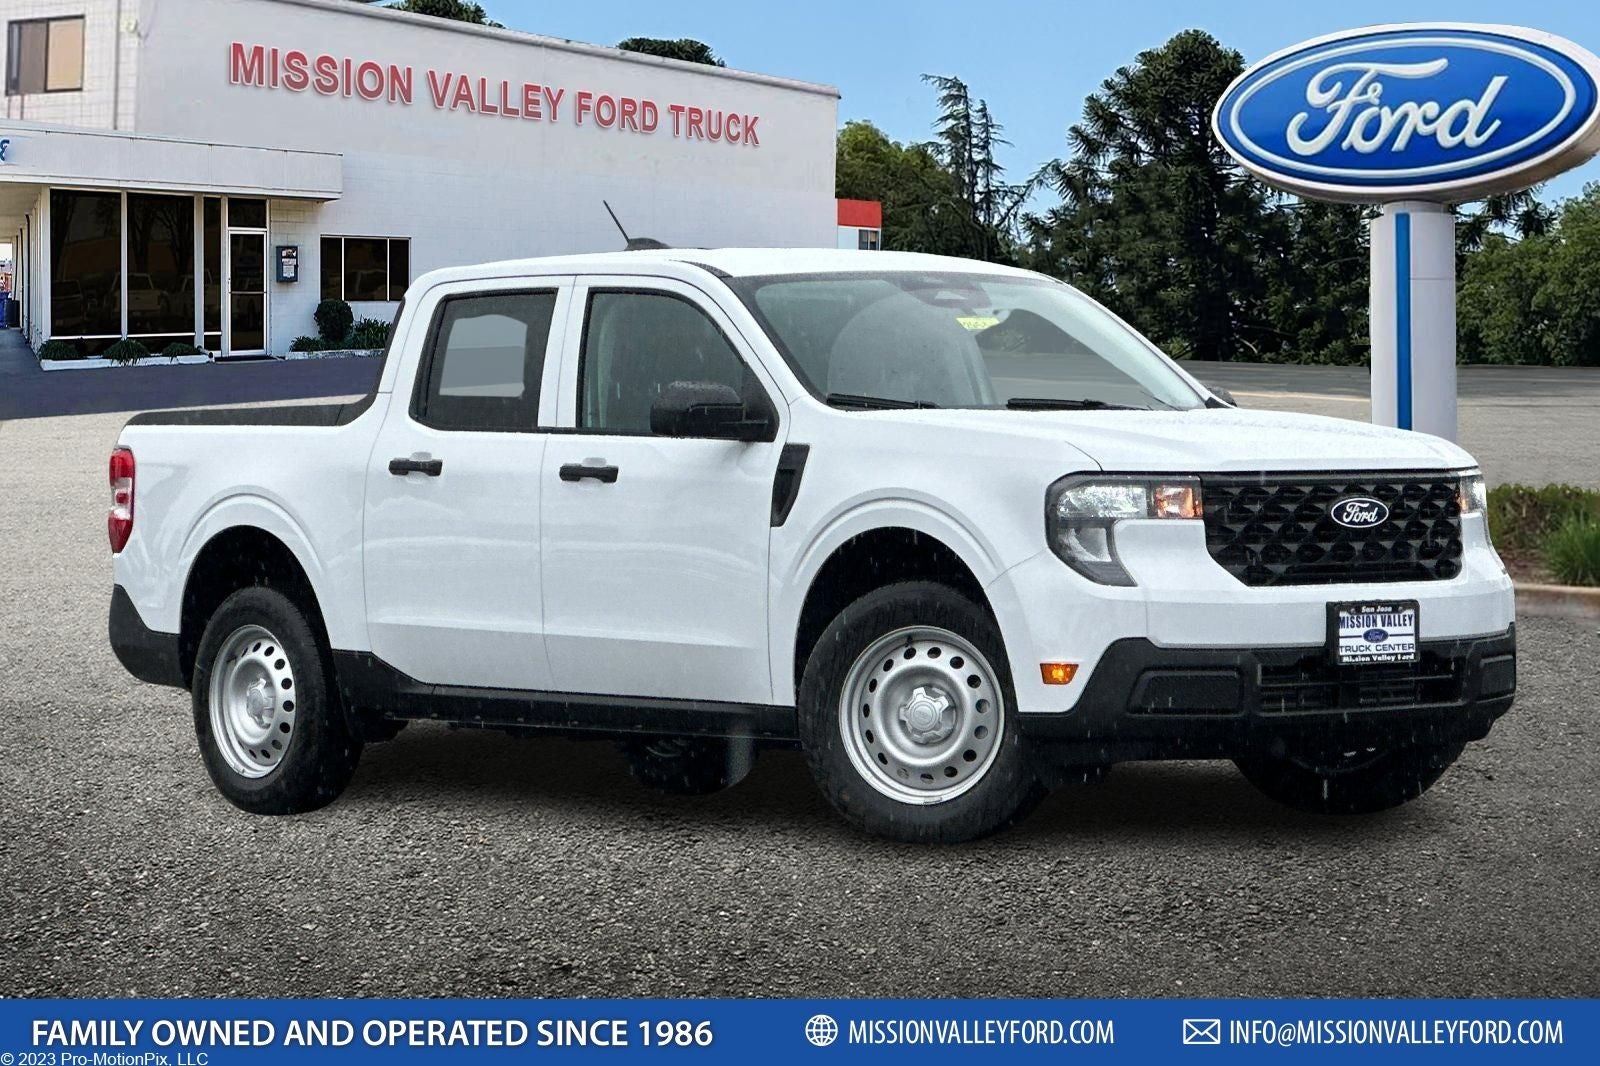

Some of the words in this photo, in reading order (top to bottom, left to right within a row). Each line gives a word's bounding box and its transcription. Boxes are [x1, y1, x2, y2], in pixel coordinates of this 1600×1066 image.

[231, 42, 413, 104] MISSION
[427, 70, 565, 121] VALLEY
[576, 91, 659, 134] FORD
[669, 104, 760, 145] TRUCK
[1286, 57, 1508, 155] Ford
[1342, 502, 1378, 523] Ford
[1339, 615, 1377, 628] MISSION
[1381, 614, 1413, 627] VALLEY
[1375, 643, 1414, 651] CENTER
[1372, 654, 1396, 662] Valley
